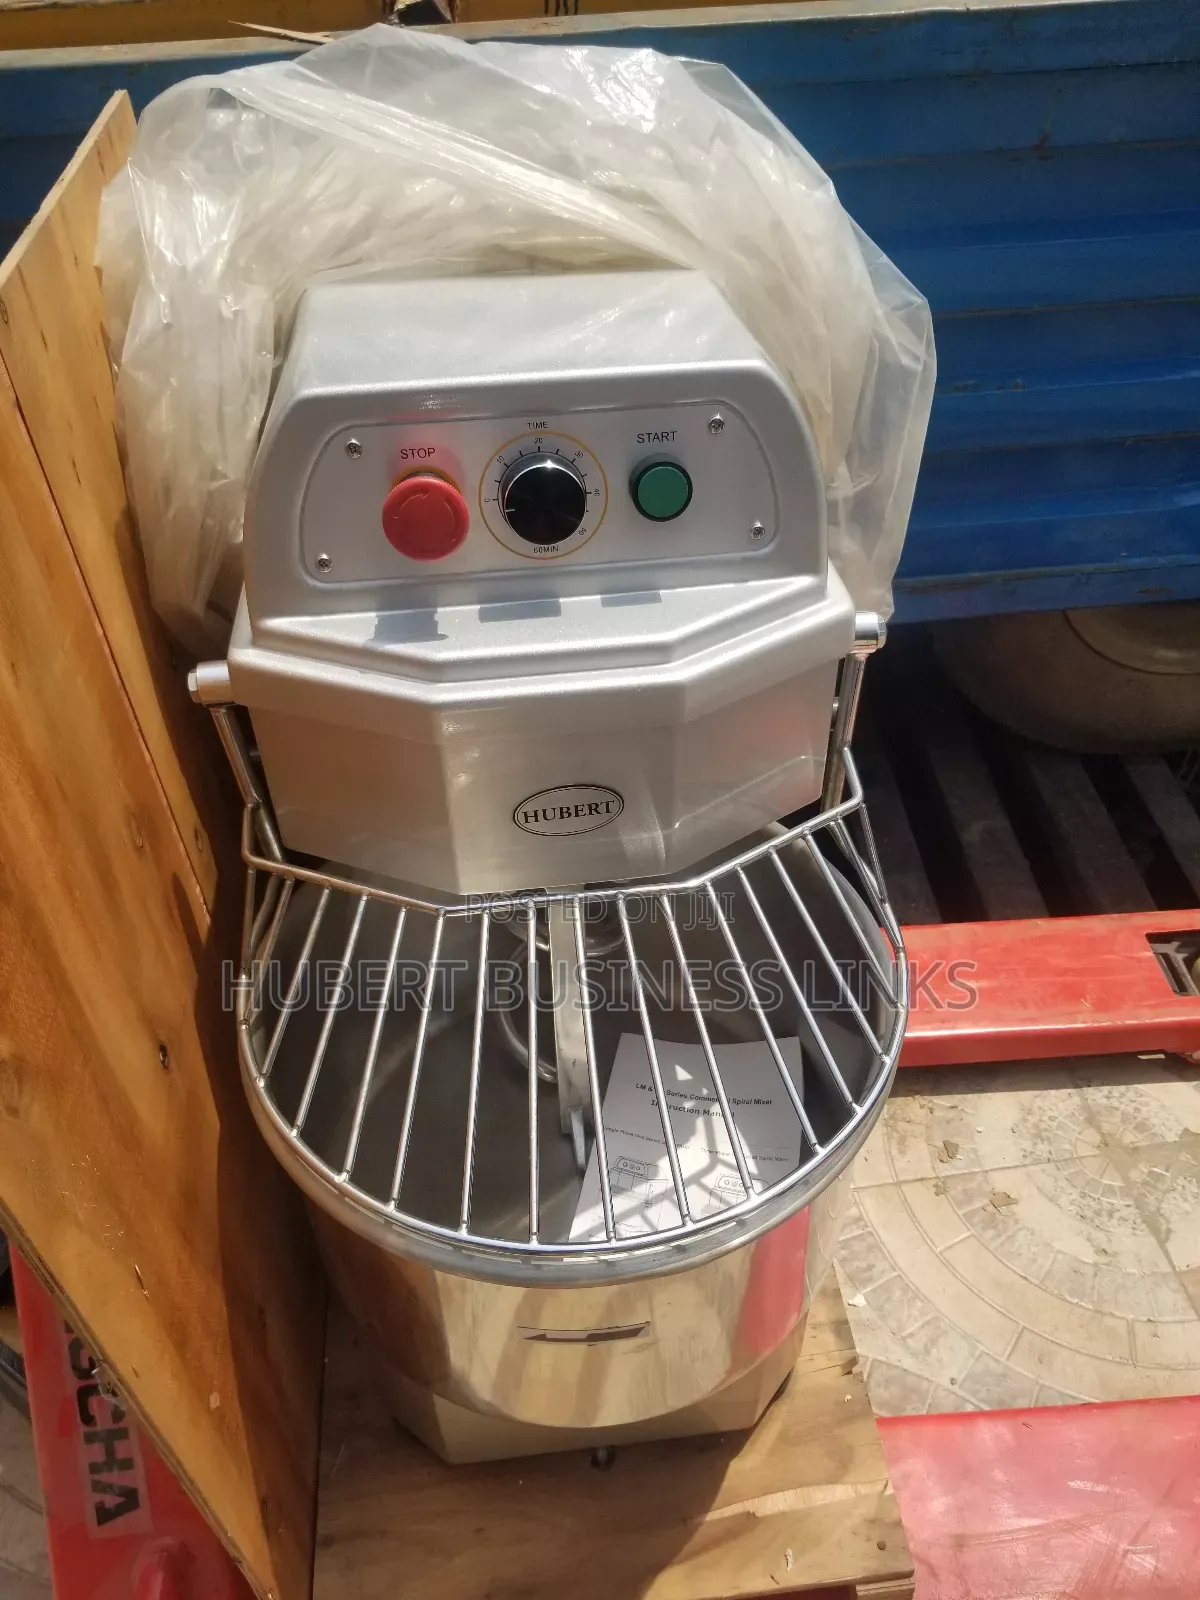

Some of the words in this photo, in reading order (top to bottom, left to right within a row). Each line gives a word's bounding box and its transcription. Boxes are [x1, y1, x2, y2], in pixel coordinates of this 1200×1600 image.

[528, 421, 549, 429] TIME
[534, 437, 543, 445] 20
[636, 431, 678, 444] START
[400, 447, 436, 460] STOP
[574, 450, 584, 459] 30
[496, 455, 505, 464] 10
[594, 488, 601, 497] 40
[533, 545, 559, 554] 60MIN
[522, 800, 615, 824] HUBERT
[635, 1082, 647, 1091] LM
[666, 1089, 688, 1099] Series
[732, 1098, 752, 1106] Spiral
